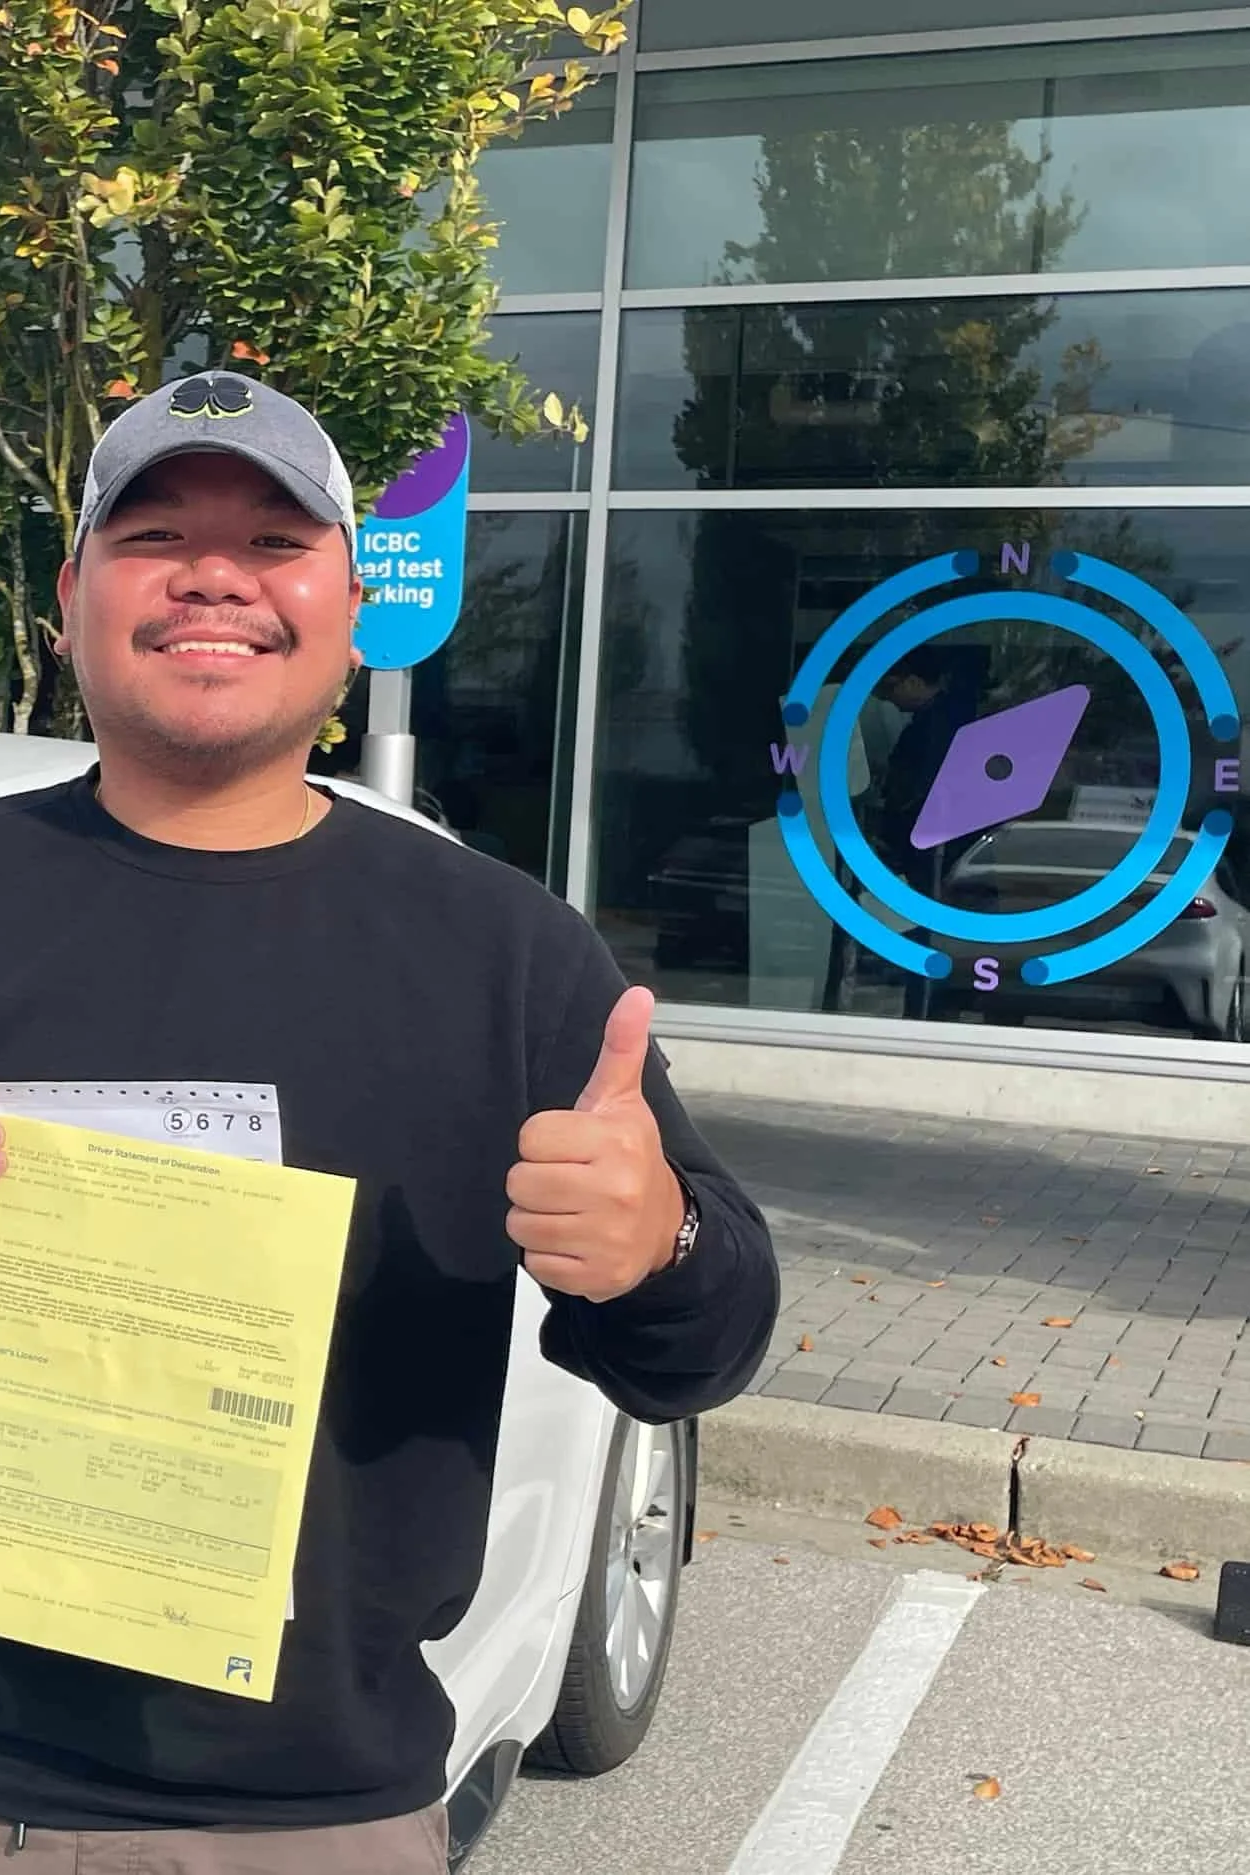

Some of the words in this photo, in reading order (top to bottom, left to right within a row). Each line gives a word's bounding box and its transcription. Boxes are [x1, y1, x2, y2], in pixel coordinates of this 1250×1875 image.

[364, 532, 421, 553] ICBC
[1001, 542, 1030, 575] N
[356, 559, 391, 579] ad
[398, 559, 443, 578] test
[368, 583, 433, 609] rking
[770, 743, 809, 775] W
[1215, 760, 1240, 792] E
[973, 957, 1000, 991] S
[170, 1113, 183, 1130] 5
[197, 1113, 209, 1130] 6
[222, 1114, 234, 1131] 7
[249, 1115, 262, 1131] 8
[88, 1144, 113, 1156] Driver
[115, 1150, 158, 1164] Statement
[171, 1160, 221, 1176] Declaration
